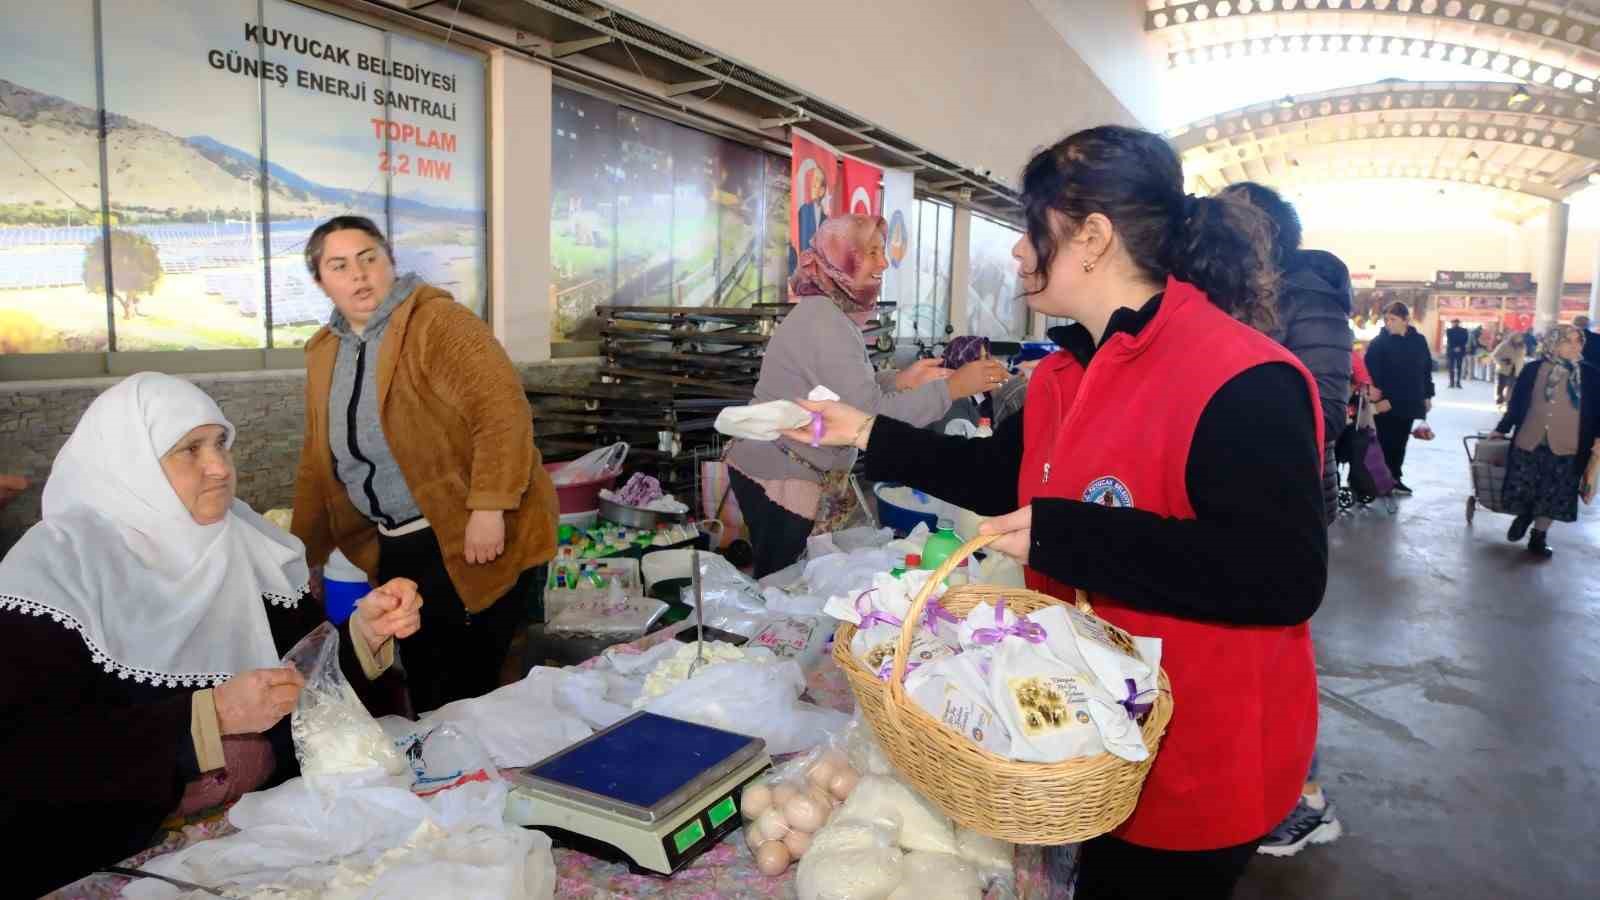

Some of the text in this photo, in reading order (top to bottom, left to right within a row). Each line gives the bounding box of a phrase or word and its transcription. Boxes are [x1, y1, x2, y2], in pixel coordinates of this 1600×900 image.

[245, 23, 457, 93] KUYUCAK BELEDİYESİ
[208, 49, 457, 121] GÜNEŞ ENERJİ SANTRALİ
[371, 118, 457, 152] TOPLAM
[378, 151, 452, 180] 2,2 MW
